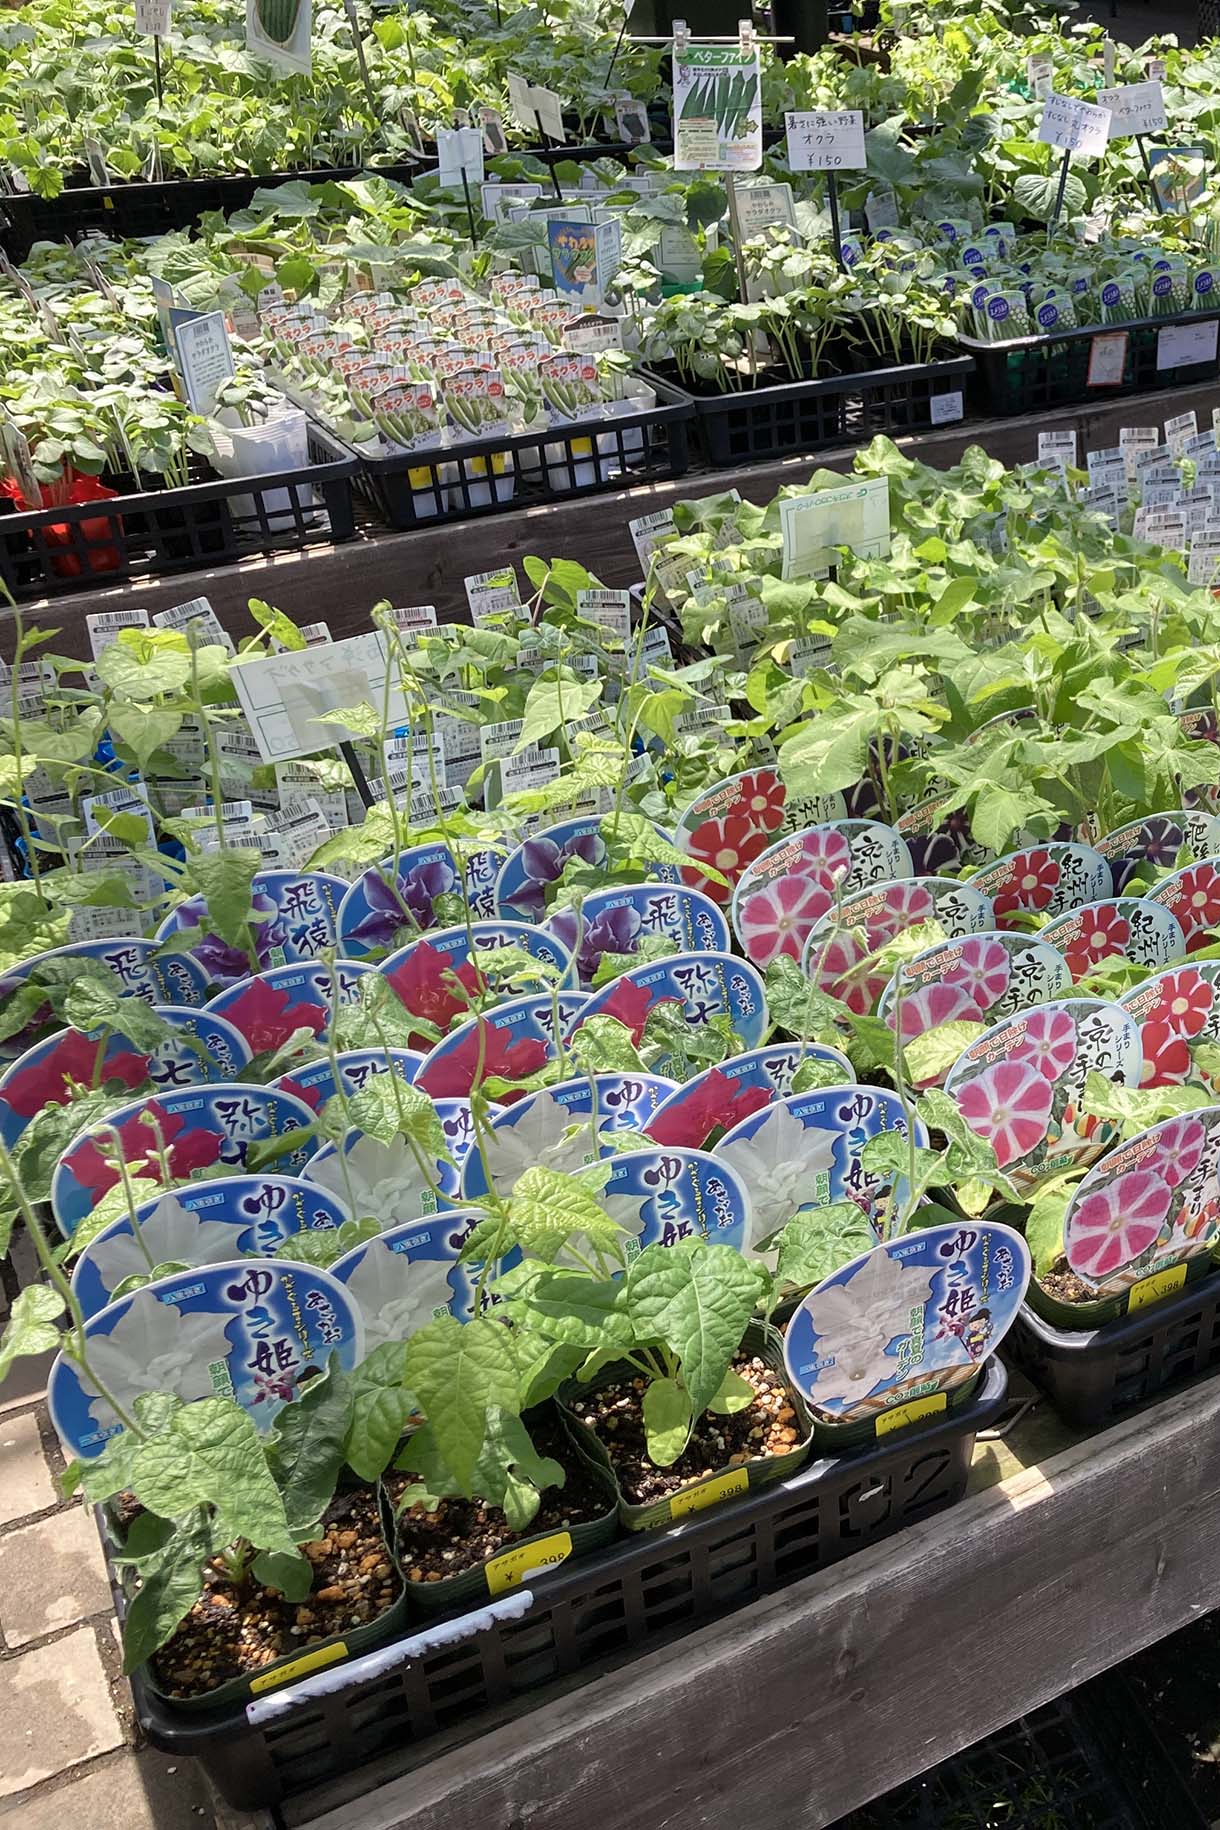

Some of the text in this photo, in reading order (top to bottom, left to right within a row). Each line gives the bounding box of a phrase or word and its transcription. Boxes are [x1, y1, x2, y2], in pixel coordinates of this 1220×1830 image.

[802, 135, 836, 145] オクラ
[807, 153, 842, 167] ¥150
[279, 881, 338, 955] 飛猿
[169, 963, 200, 1003] あさがお
[731, 975, 756, 1016] あさがお
[208, 1034, 236, 1079] あさがお
[968, 1020, 1028, 1061] 朝顔で日除け
[986, 1035, 1025, 1063] カーテン
[839, 1093, 880, 1191] ゆき姫
[706, 1178, 735, 1229] あさがお
[938, 1229, 978, 1317] ゆき姫
[993, 1246, 1014, 1292] あさがお
[1160, 1280, 1179, 1295] 398
[226, 1269, 300, 1376] ゆき姫
[305, 1291, 343, 1347] あさがお
[720, 1484, 743, 1500] 398
